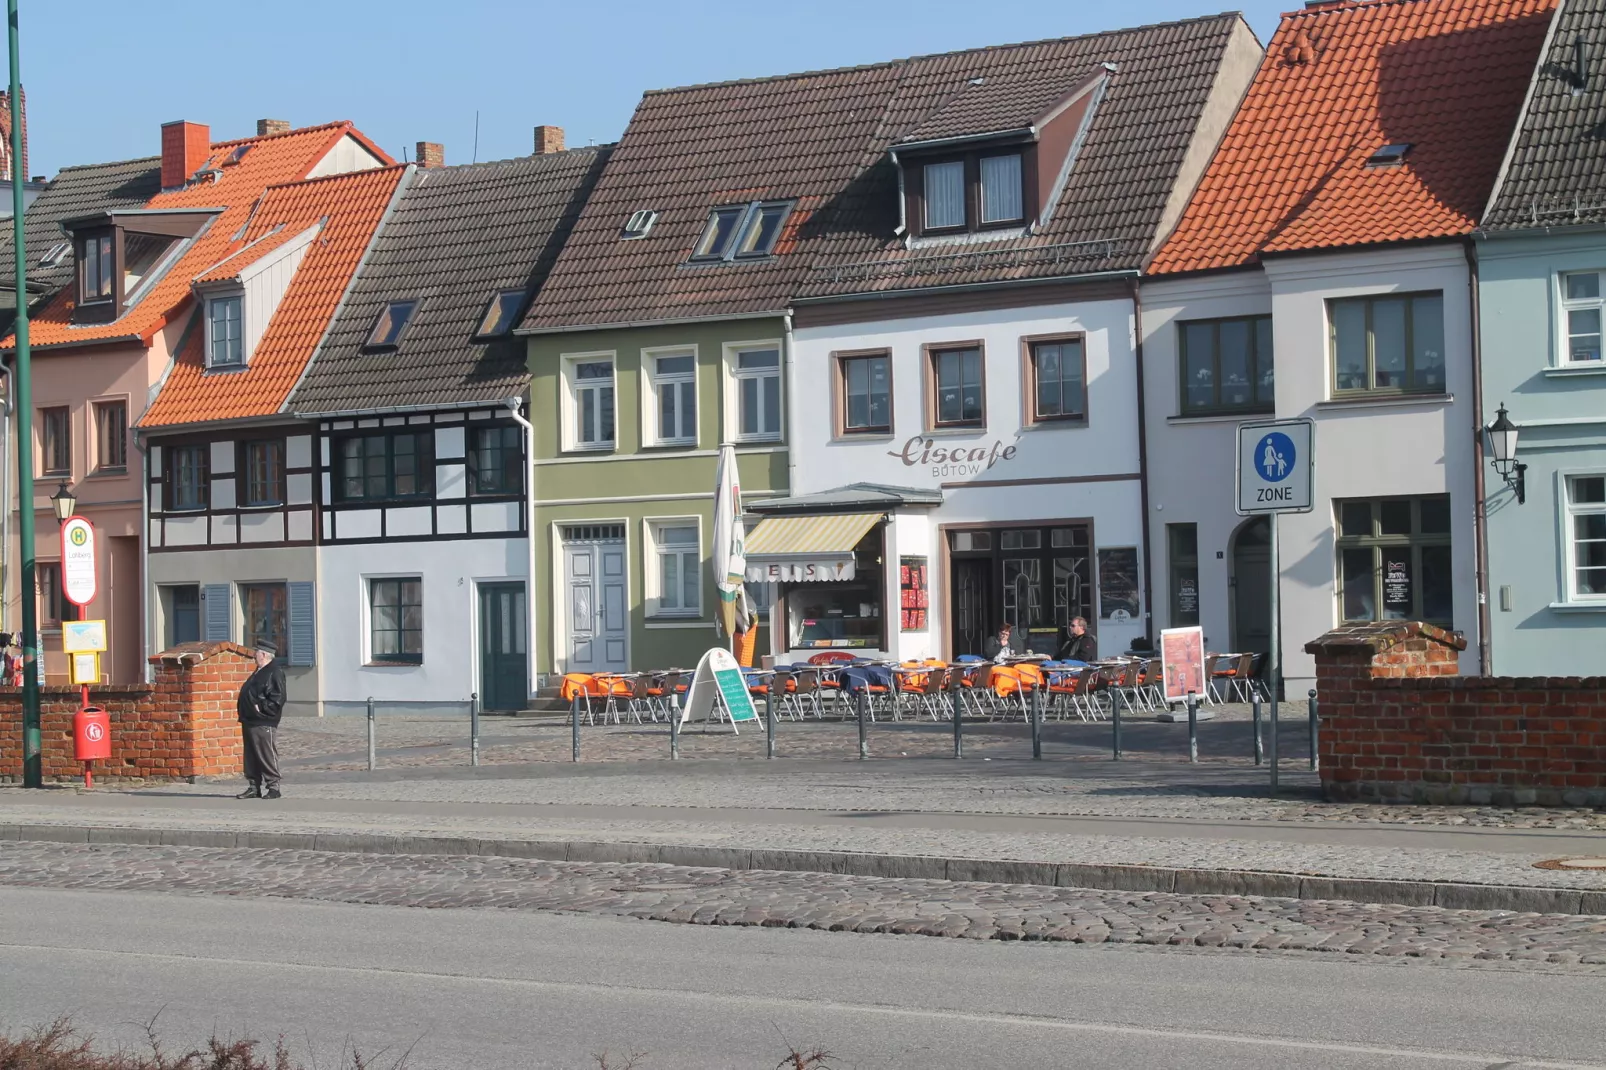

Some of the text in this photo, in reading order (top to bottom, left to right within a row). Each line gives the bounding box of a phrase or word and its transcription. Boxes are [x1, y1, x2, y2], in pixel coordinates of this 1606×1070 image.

[887, 435, 1022, 470] Eiscafé
[932, 464, 980, 477] BÜTOW
[1257, 486, 1293, 502] ZONE
[75, 531, 83, 541] H
[769, 564, 815, 576] EIS
